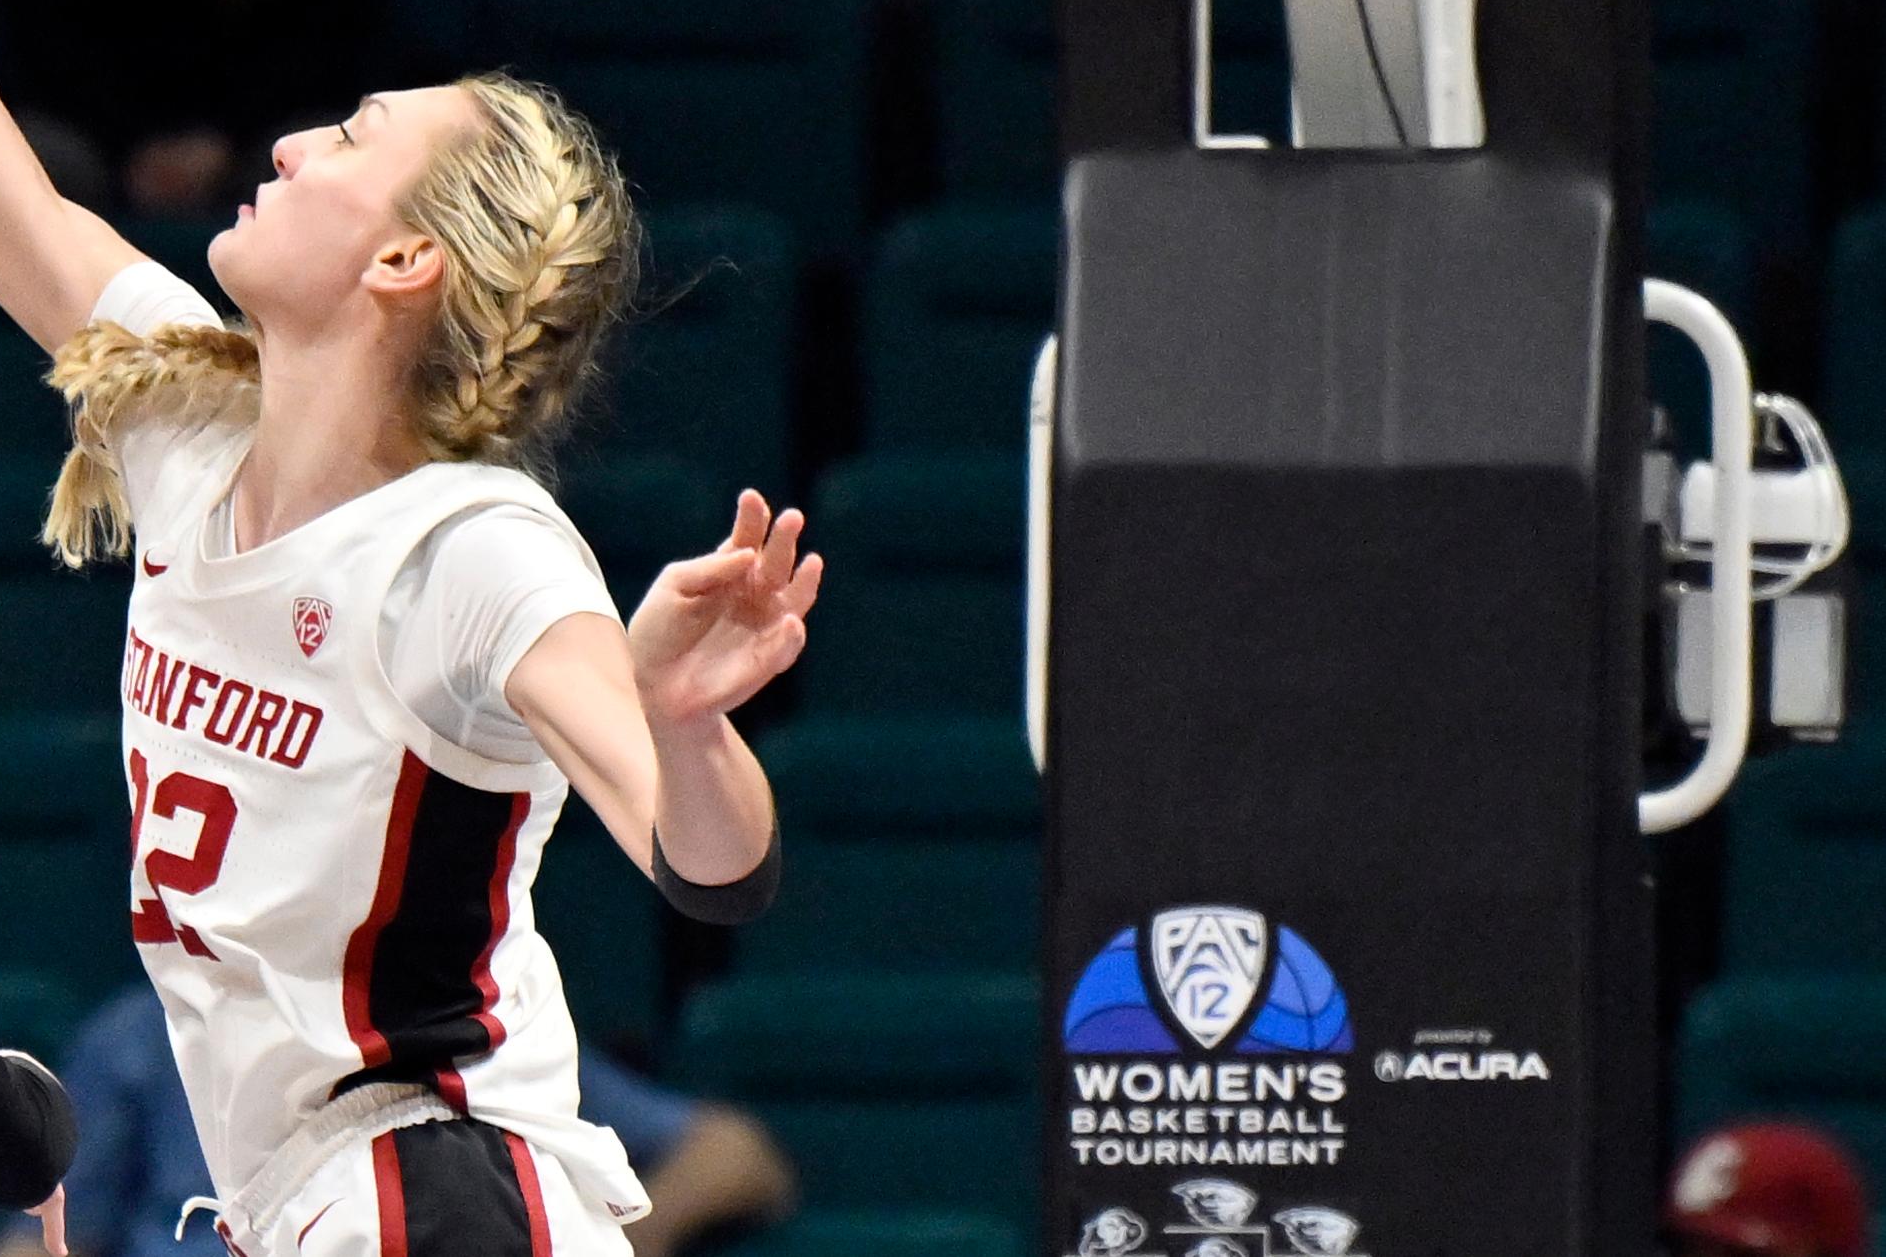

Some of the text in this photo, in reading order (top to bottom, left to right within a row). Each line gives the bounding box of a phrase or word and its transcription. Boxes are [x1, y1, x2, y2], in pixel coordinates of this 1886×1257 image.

[299, 622, 321, 647] 12
[125, 626, 324, 770] TANFORD
[1156, 912, 1263, 998] PAC
[1188, 981, 1231, 1019] 12
[1074, 1063, 1347, 1103] WOMEN'S
[1403, 1051, 1552, 1081] ACURA
[1070, 1107, 1345, 1135] BASKETBALL
[1070, 1139, 1345, 1166] TOURNAMENT
